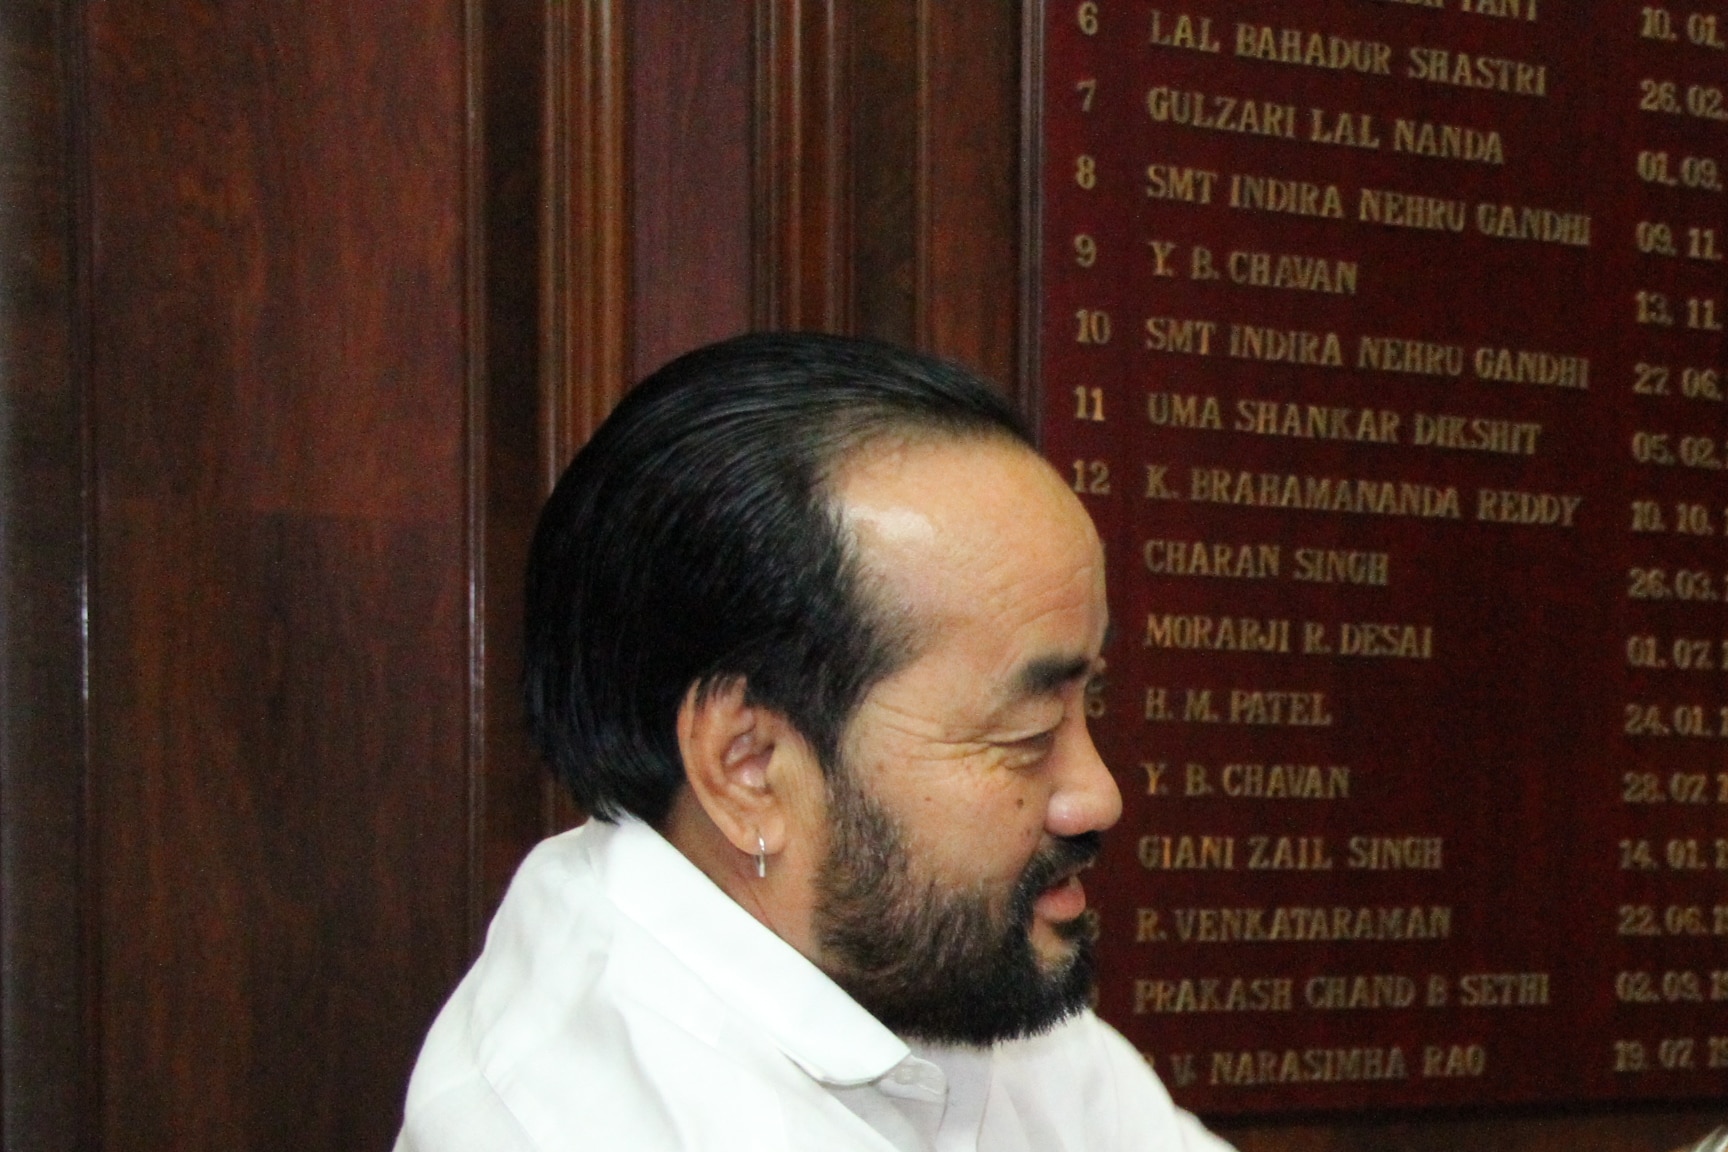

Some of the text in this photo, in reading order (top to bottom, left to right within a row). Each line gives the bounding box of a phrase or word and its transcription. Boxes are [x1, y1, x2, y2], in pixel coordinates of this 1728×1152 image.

[1076, 0, 1099, 36] 6
[1150, 9, 1221, 53] LAL
[1234, 22, 1392, 75] BAHADUR
[1407, 46, 1547, 97] SHASTRI
[1075, 77, 1097, 112] 7
[1145, 85, 1296, 139] GULZARI
[1309, 107, 1381, 149] LAL
[1392, 117, 1504, 165] NANDA
[1074, 154, 1097, 190] 8
[1145, 163, 1218, 205] SMT
[1228, 174, 1345, 219] INDIRA
[1358, 187, 1466, 233] NEHRU
[1475, 202, 1592, 247] GANDHI
[1072, 233, 1098, 268] 9
[1226, 249, 1358, 295] CHAVAN
[1074, 307, 1112, 344] 10
[1144, 316, 1217, 356] SMT
[1228, 324, 1343, 367] INDIRA
[1357, 335, 1464, 377] NEHRU
[1473, 346, 1589, 389] GANDHI
[1074, 385, 1106, 422] 11
[1146, 392, 1223, 430] UMA
[1234, 398, 1401, 443] SHANKAR
[1412, 412, 1542, 456] DIKSHIT
[1071, 459, 1111, 497] 12
[1189, 467, 1461, 519] BRAHAMANANDA
[1476, 488, 1582, 527] REDDY
[1142, 538, 1281, 579] CHARAN
[1292, 547, 1390, 586] SINGH
[1143, 612, 1290, 653] MORARJI
[1338, 622, 1433, 659] DESAI
[1228, 688, 1333, 726] PATEL
[1220, 763, 1350, 799] CHAVAN
[1137, 835, 1235, 870] GIANI
[1246, 835, 1333, 871] ZAIL
[1347, 835, 1443, 871] SINGH
[1173, 905, 1451, 943] VENKATARAMAN
[1133, 977, 1293, 1015] PRAKASH
[1304, 974, 1416, 1010] CHAND
[1458, 972, 1550, 1007] SETHI
[1208, 1046, 1406, 1086] NARASIMHA
[1422, 1043, 1486, 1078] RAO
